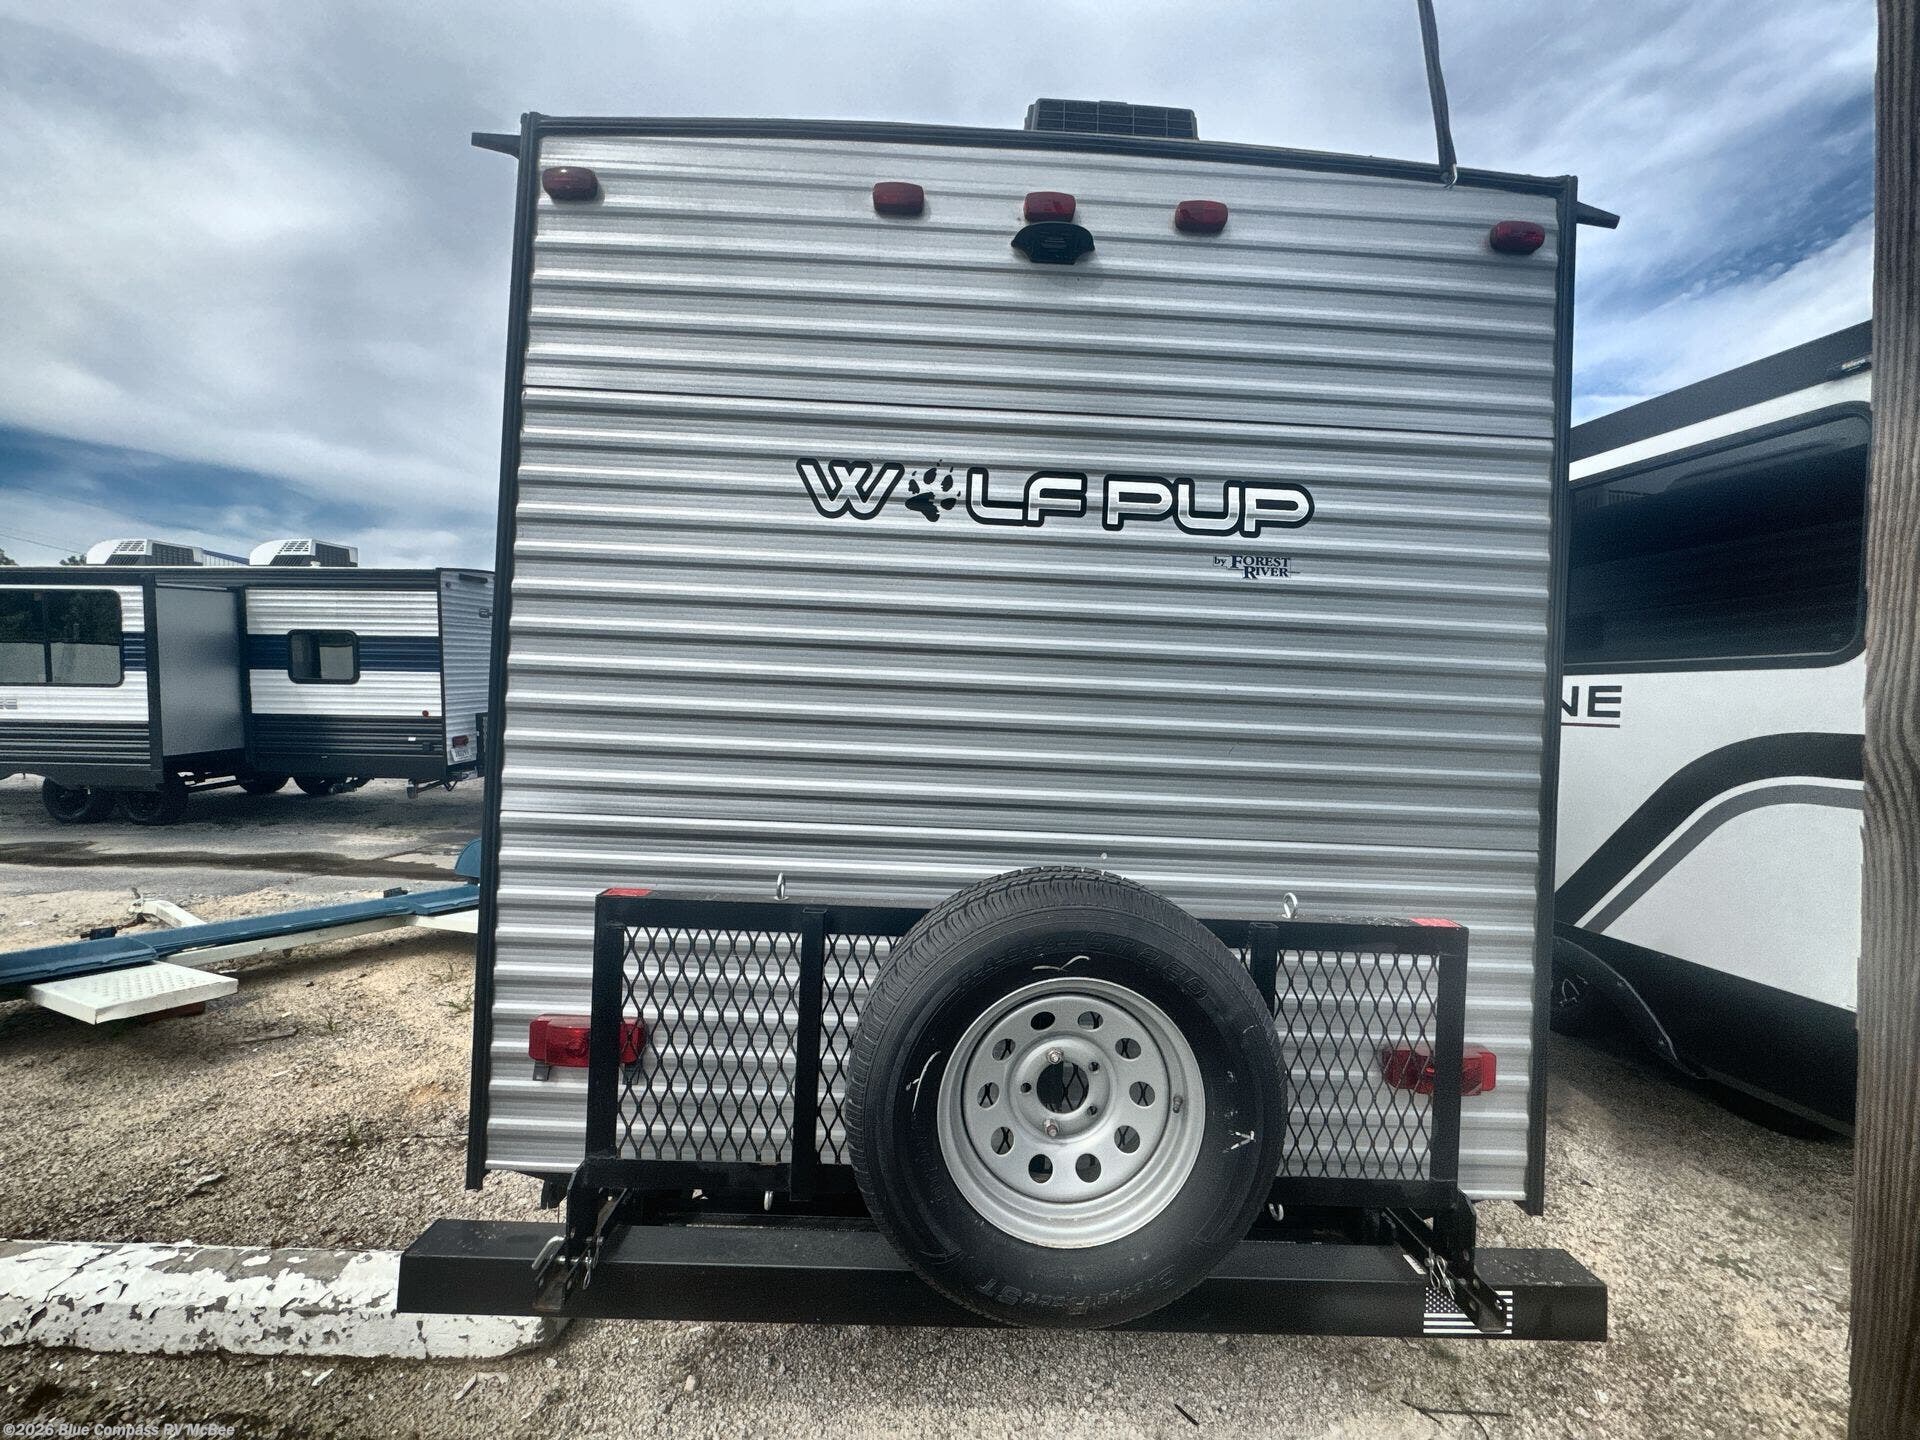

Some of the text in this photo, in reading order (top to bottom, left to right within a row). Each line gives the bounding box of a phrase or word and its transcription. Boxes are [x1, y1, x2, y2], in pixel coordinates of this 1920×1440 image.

[1102, 474, 1315, 538] PUP
[1214, 555, 1291, 569] by FOREST
[1243, 565, 1290, 580] RIVER
